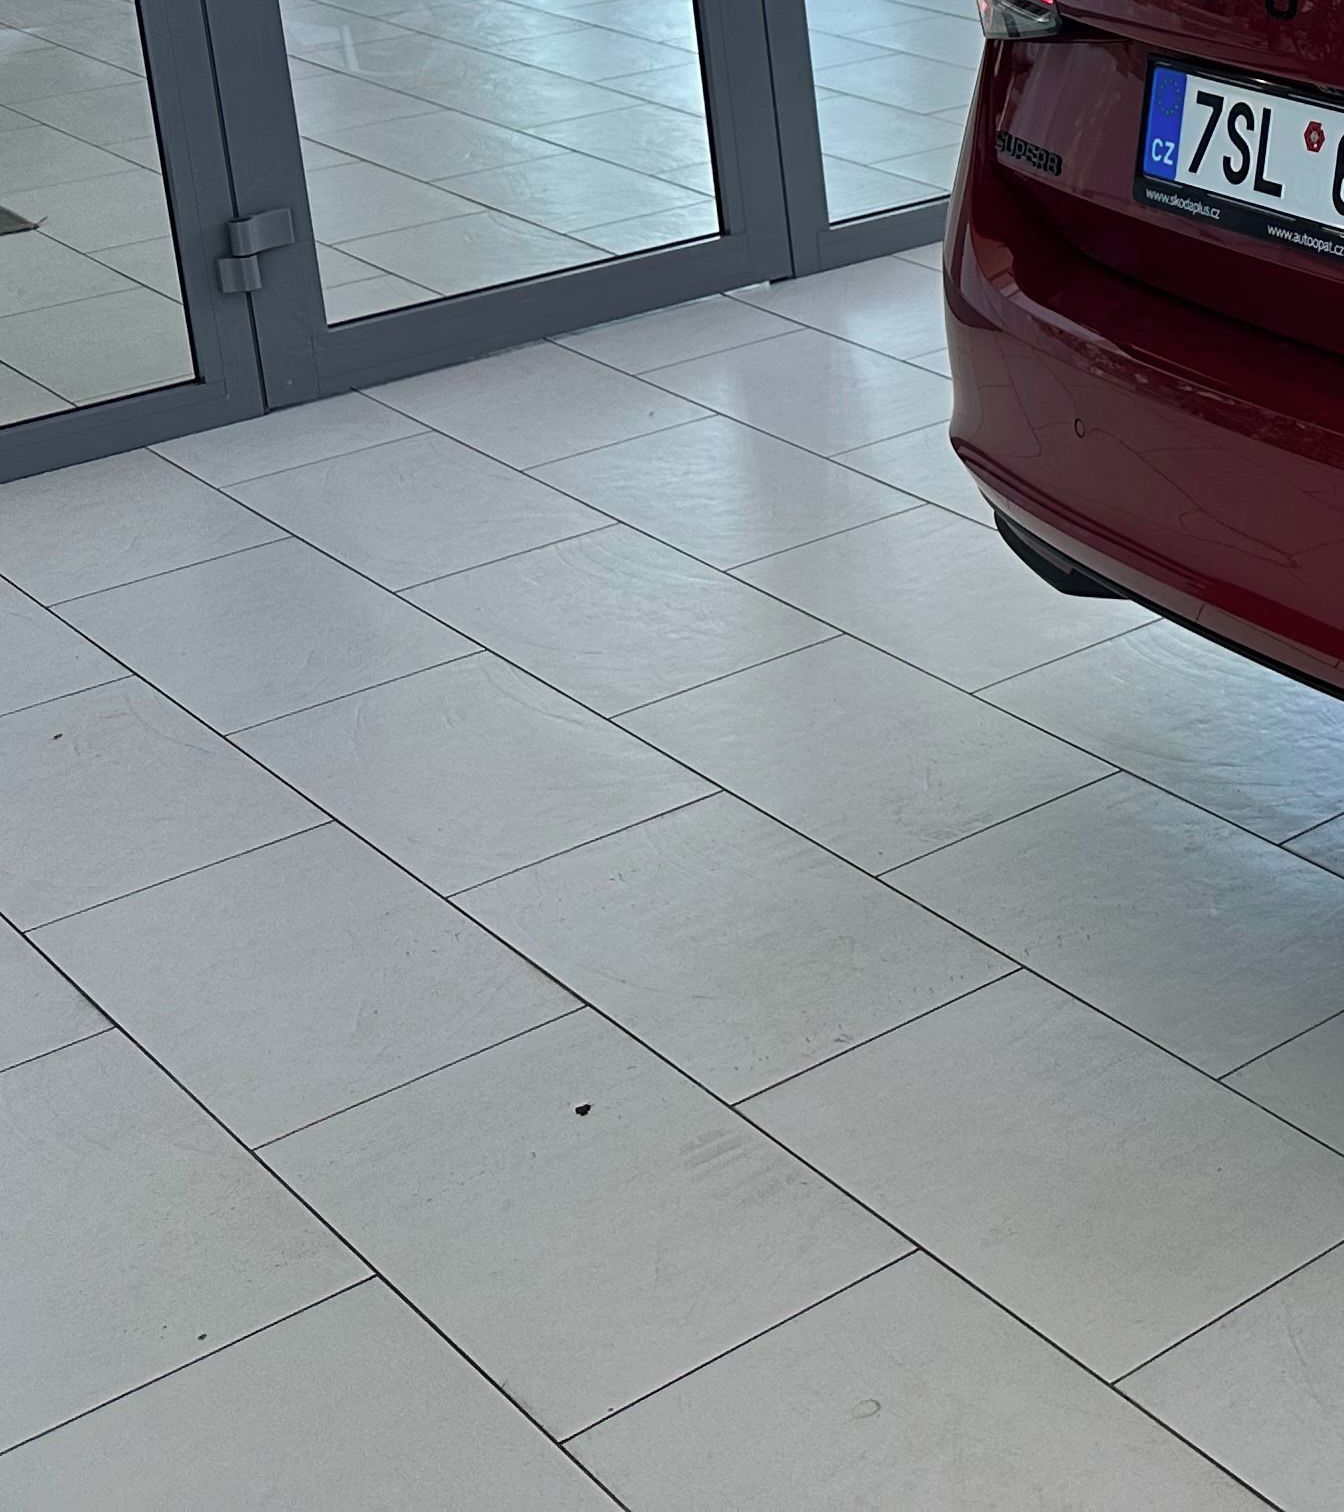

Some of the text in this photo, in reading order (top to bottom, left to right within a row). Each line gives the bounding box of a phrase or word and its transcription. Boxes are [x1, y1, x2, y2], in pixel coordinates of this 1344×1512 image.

[1151, 138, 1174, 165] CZ
[1188, 90, 1283, 198] 7SL
[1146, 188, 1221, 220] www.skodaplus.cz
[1267, 224, 1344, 257] www.autoopat.cz
